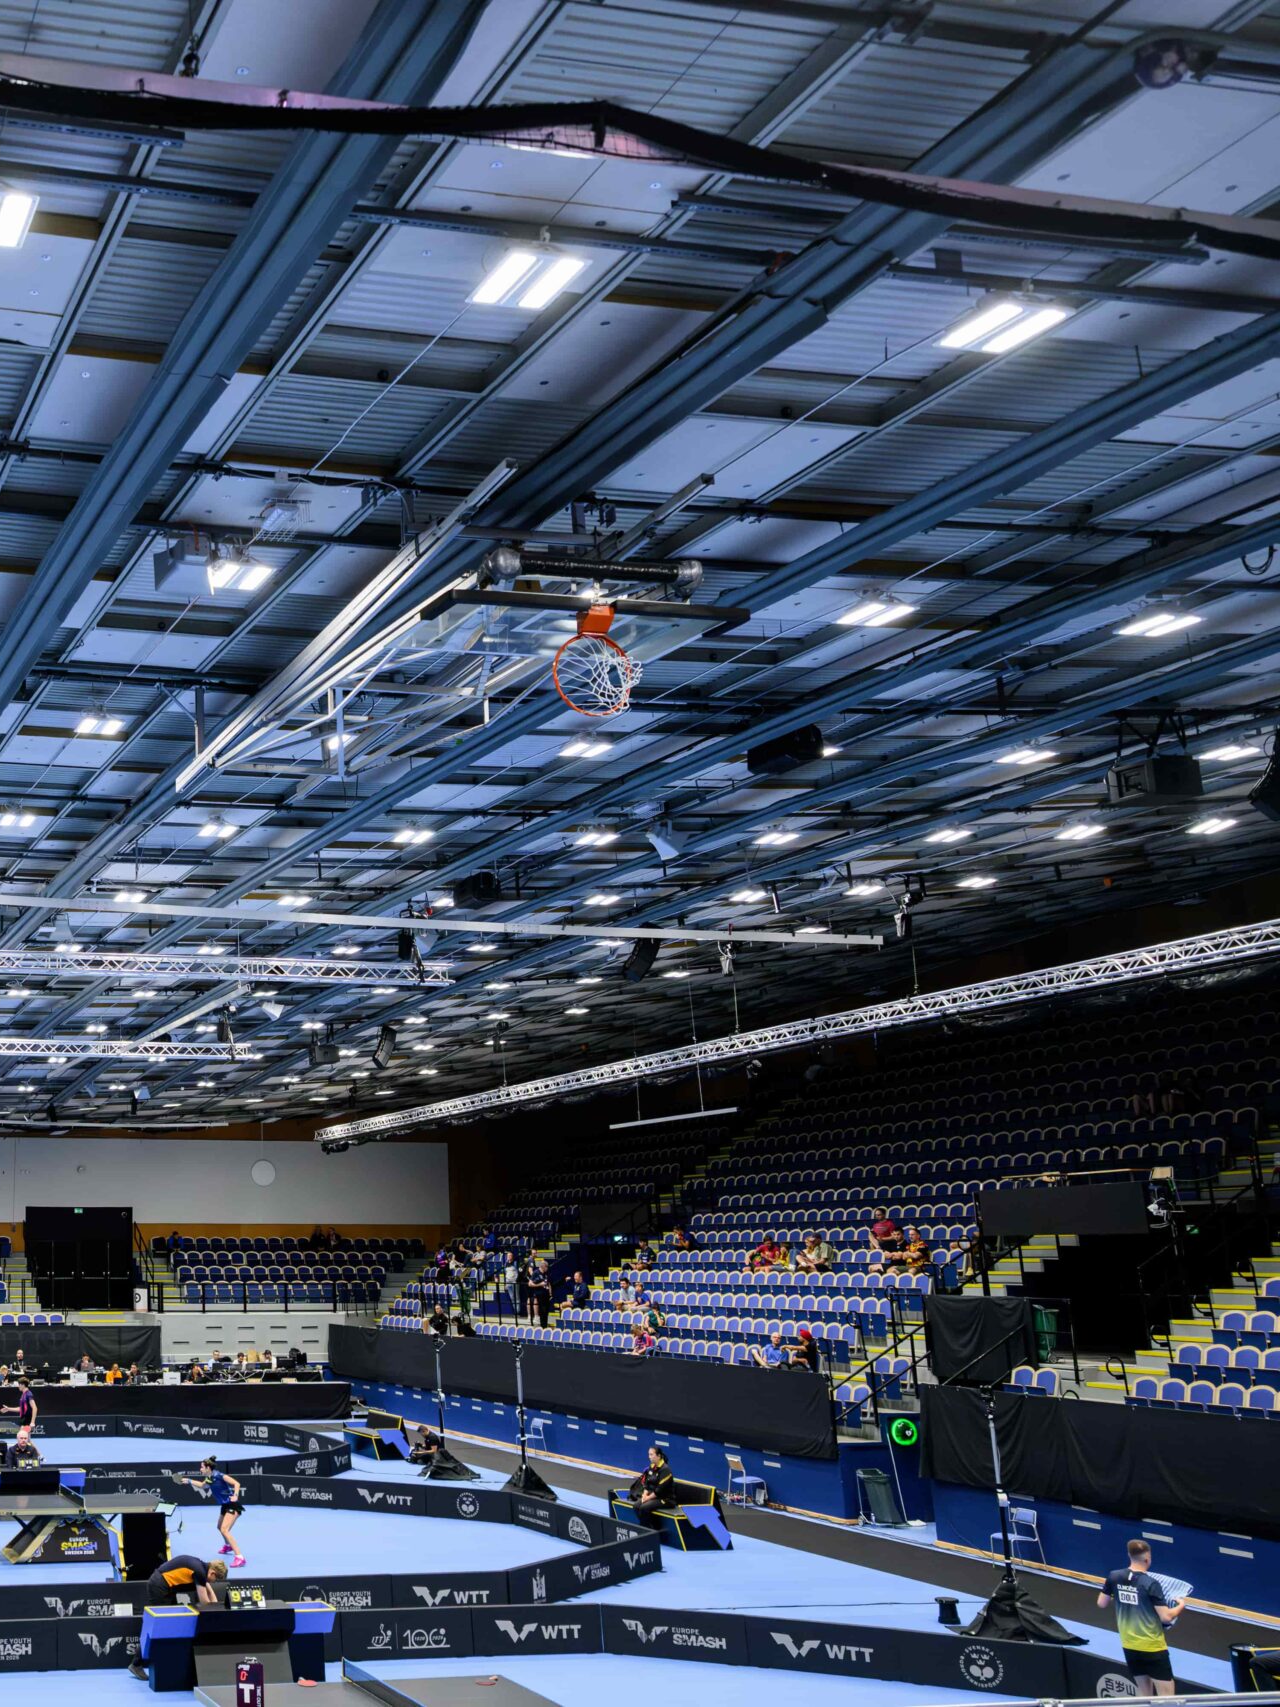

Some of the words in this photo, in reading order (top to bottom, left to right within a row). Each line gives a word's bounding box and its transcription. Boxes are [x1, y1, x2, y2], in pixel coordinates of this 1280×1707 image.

[87, 1424, 107, 1432] WTT
[201, 1428, 219, 1436] WTT
[244, 1429, 257, 1437] ON
[301, 1492, 332, 1501] SMASH
[386, 1494, 412, 1506] WTT
[61, 1541, 97, 1551] SMASH
[638, 1551, 654, 1565] WTT
[591, 1566, 610, 1579] SMASH
[232, 1591, 240, 1602] 9
[252, 1590, 262, 1601] 8
[329, 1596, 372, 1606] SMASH
[453, 1591, 490, 1604] WTT
[88, 1605, 115, 1616] SMA
[541, 1624, 582, 1640] WTT
[672, 1627, 699, 1636] EUROPE
[672, 1633, 727, 1650] SMASH
[825, 1644, 874, 1663] WTT
[964, 1645, 994, 1656] SVENSKA
[238, 1683, 255, 1703] T
[1104, 1677, 1136, 1697] 百岁山
